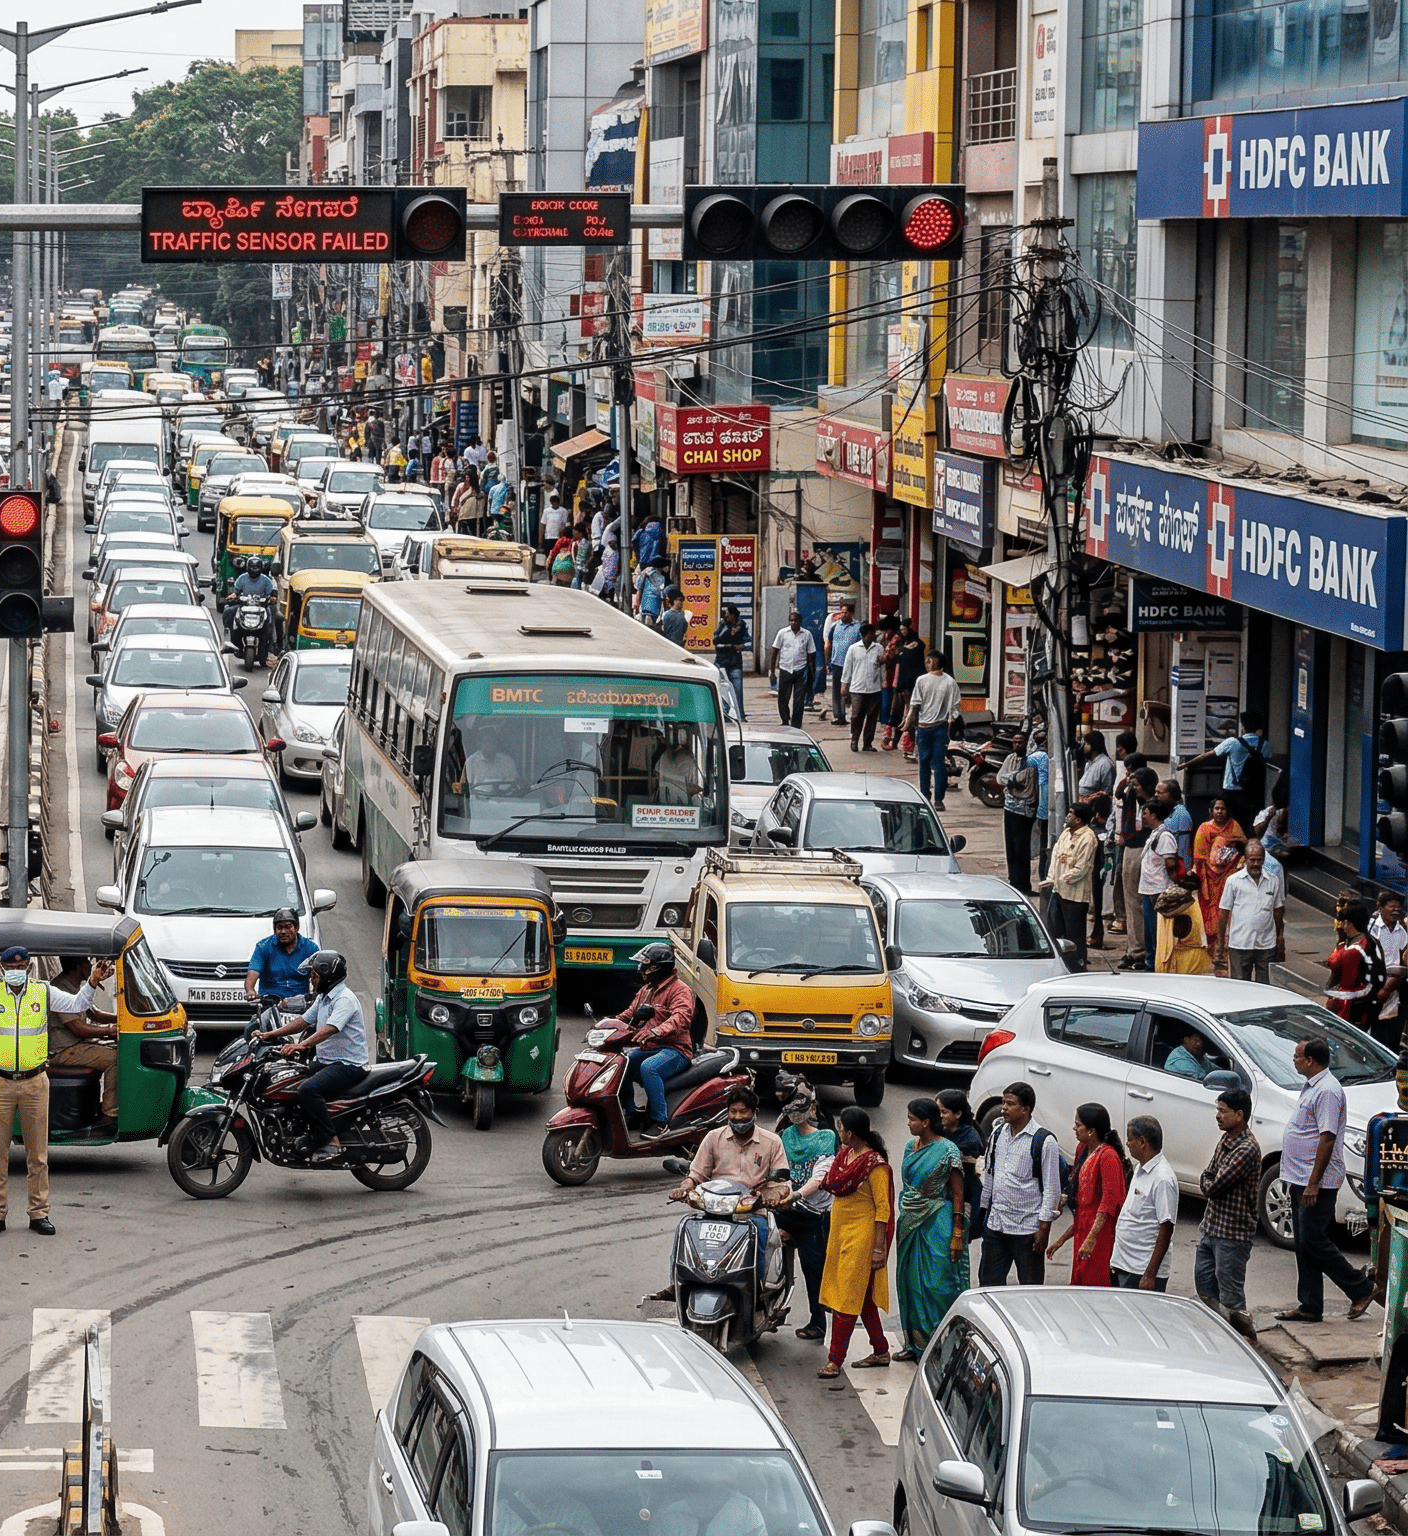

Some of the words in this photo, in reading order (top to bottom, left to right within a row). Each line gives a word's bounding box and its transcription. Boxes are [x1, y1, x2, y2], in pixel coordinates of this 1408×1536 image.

[1239, 134, 1306, 190] HDFC
[1313, 128, 1391, 187] BANK
[149, 232, 231, 251] TRAFFIC
[236, 232, 316, 251] SENSOR
[322, 232, 389, 251] FAILED
[683, 450, 718, 464] CHAI
[722, 448, 762, 463] SHOP
[1241, 518, 1302, 587] HDFC
[1308, 535, 1378, 609] BANK
[1138, 605, 1179, 618] HDFC
[1183, 605, 1226, 617] BANK
[492, 688, 544, 703] BMTC
